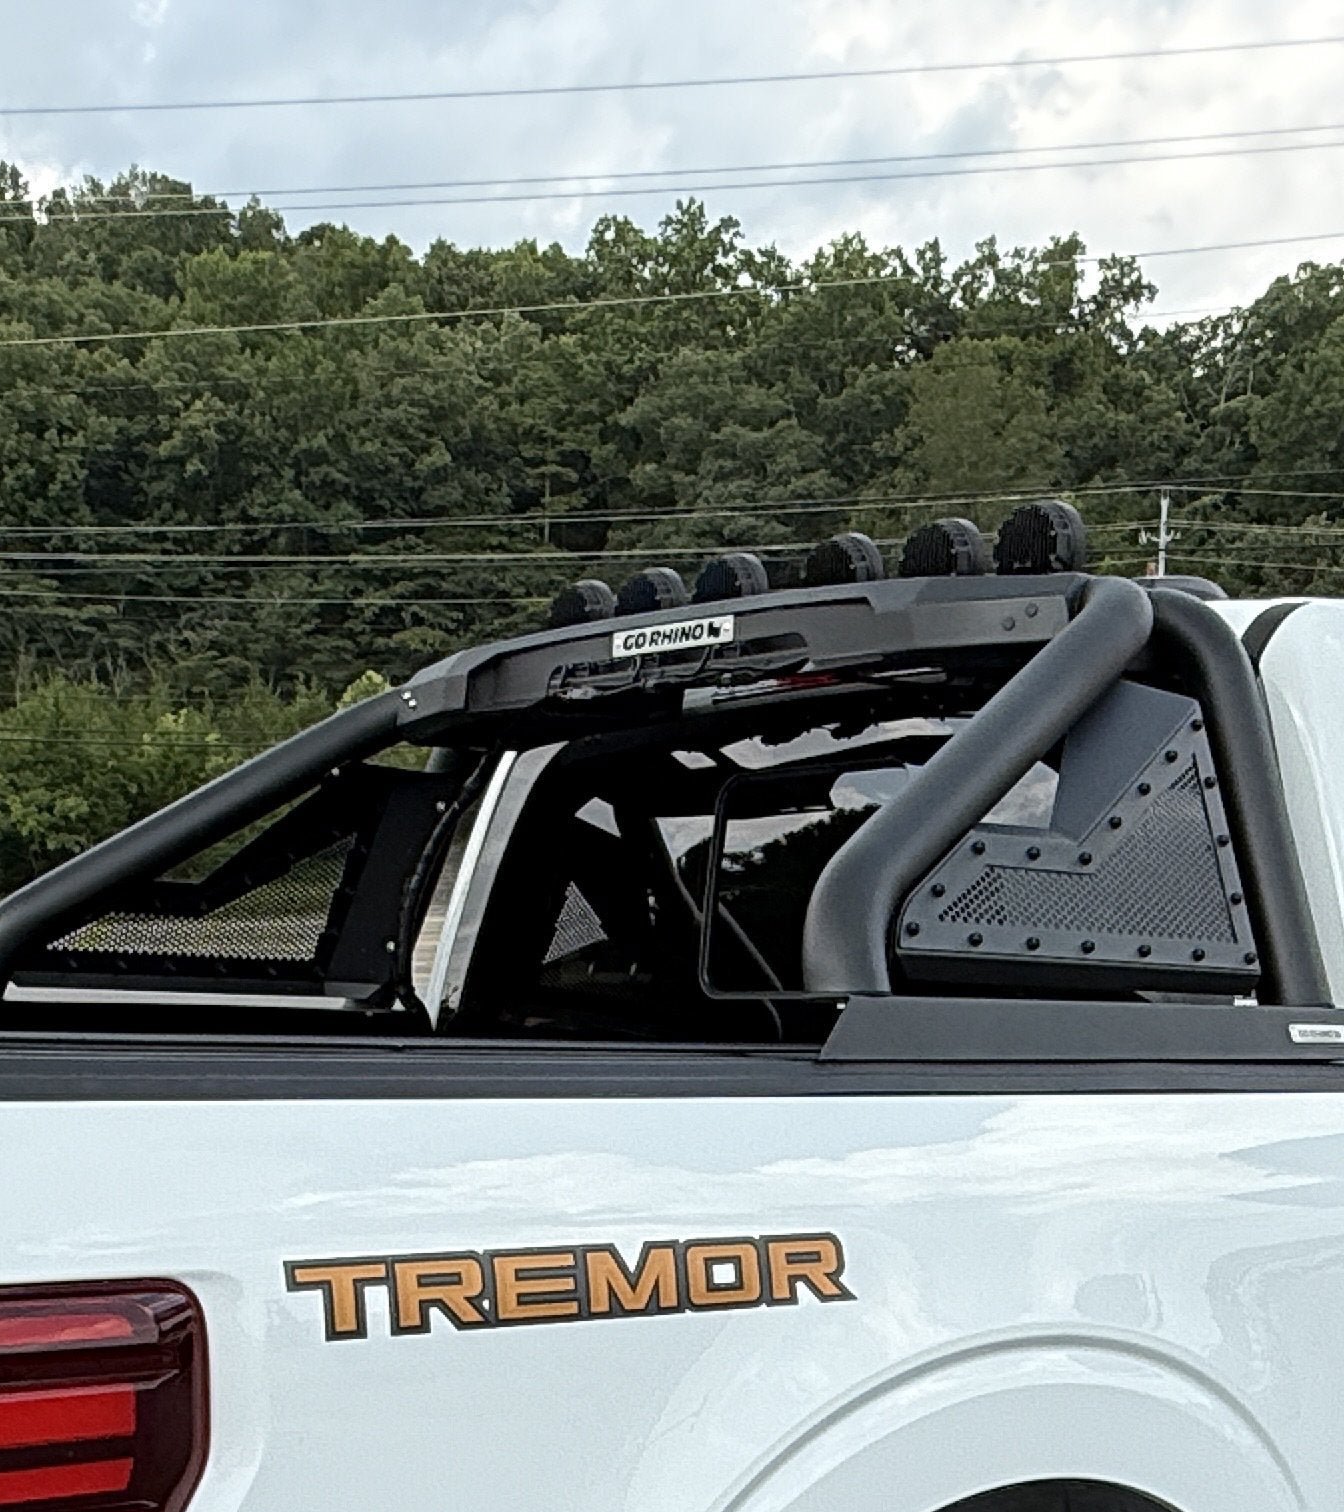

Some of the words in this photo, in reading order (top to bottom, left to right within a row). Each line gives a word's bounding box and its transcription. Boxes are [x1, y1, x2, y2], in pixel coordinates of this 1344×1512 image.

[622, 631, 647, 652] GO
[648, 623, 704, 648] RHINO
[283, 1232, 858, 1342] TREMOR
